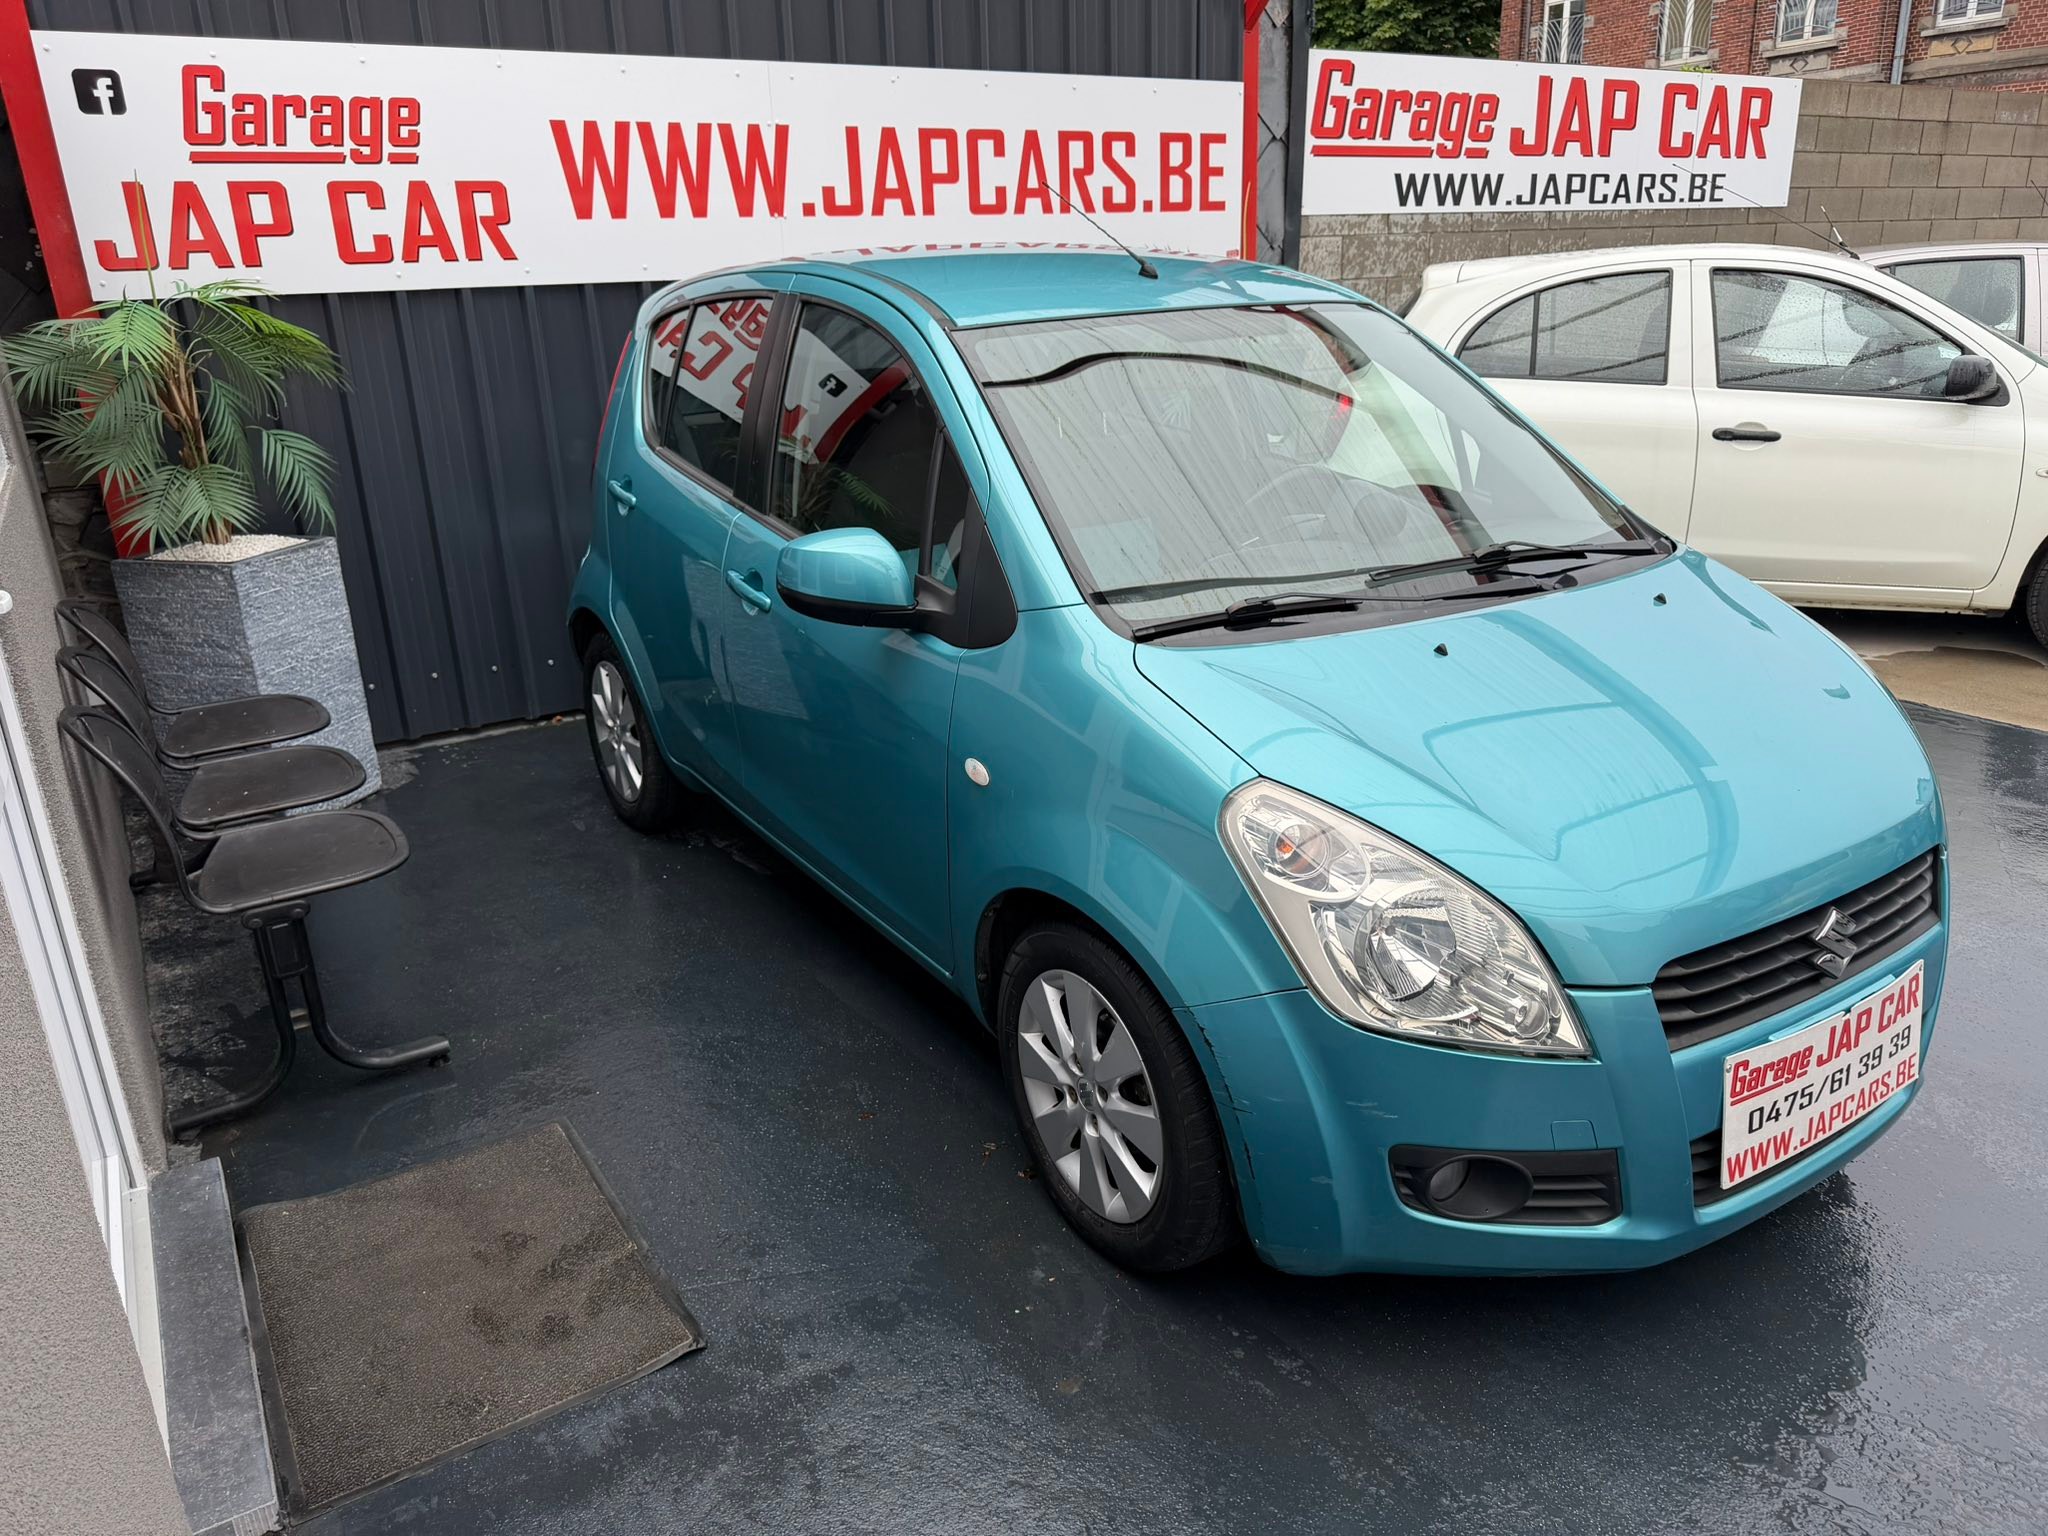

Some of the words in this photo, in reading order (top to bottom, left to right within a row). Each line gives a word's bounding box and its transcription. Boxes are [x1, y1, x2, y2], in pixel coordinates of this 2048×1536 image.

[182, 64, 421, 165] Garage
[1310, 58, 1500, 159] Garage
[1509, 75, 1640, 158] JAP
[1658, 82, 1774, 160] CAR
[549, 118, 1228, 221] WWW.JAPCARS.BE
[1394, 172, 1727, 207] WWW.JAPCARS.BE
[94, 180, 294, 271] JAP
[326, 180, 518, 265] CAR
[1729, 1045, 1814, 1107] Garage
[1816, 1006, 1873, 1068] JAP
[1877, 971, 1921, 1035] CAR
[1747, 1064, 1852, 1135] 0475/61
[1857, 1043, 1883, 1080] 39
[1889, 1024, 1912, 1059] 39
[1726, 1052, 1917, 1185] WWW.JAPCARS.BE
